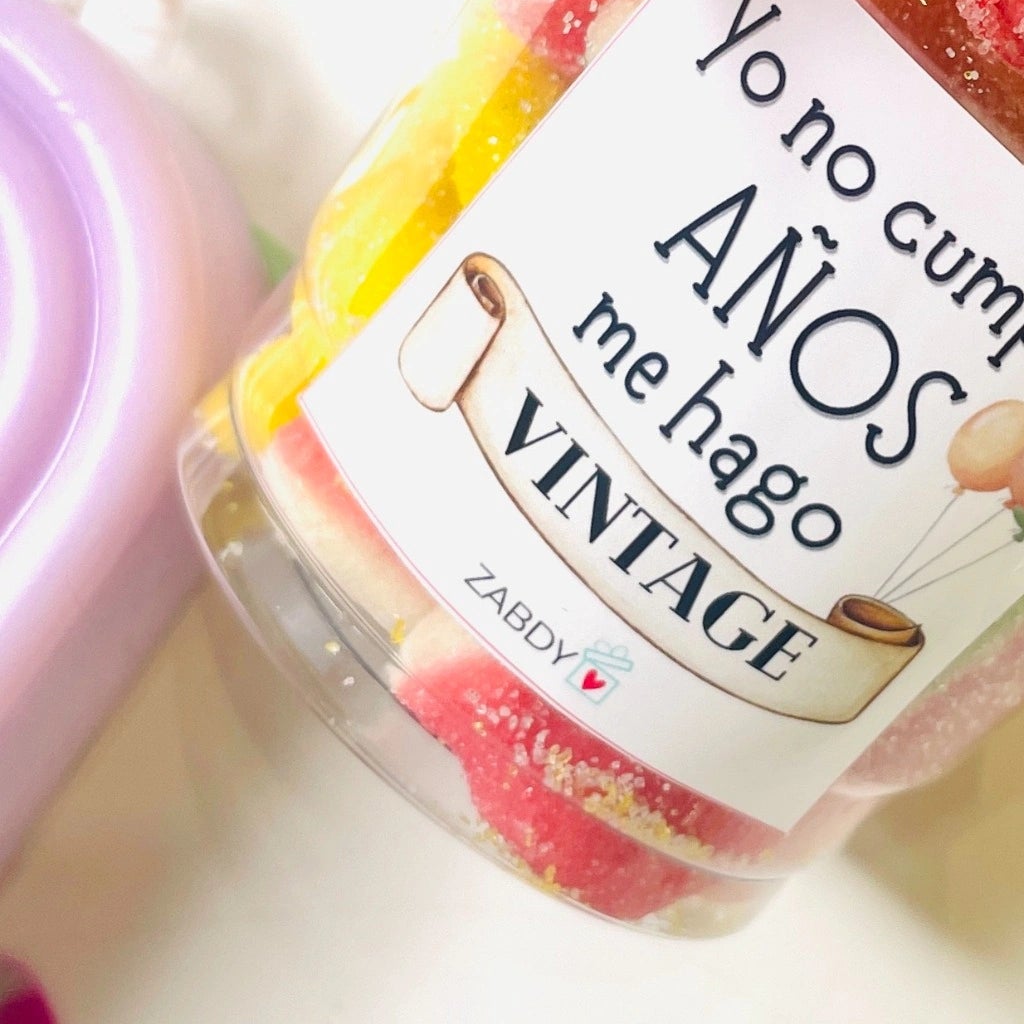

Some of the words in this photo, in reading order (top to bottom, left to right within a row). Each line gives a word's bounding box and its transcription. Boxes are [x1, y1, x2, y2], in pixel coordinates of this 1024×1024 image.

[780, 97, 878, 199] no
[570, 291, 670, 403] me
[658, 359, 843, 550] hago
[653, 182, 969, 467] AÑOS
[463, 562, 579, 667] ZABDY
[503, 386, 819, 681] VINTAGE
